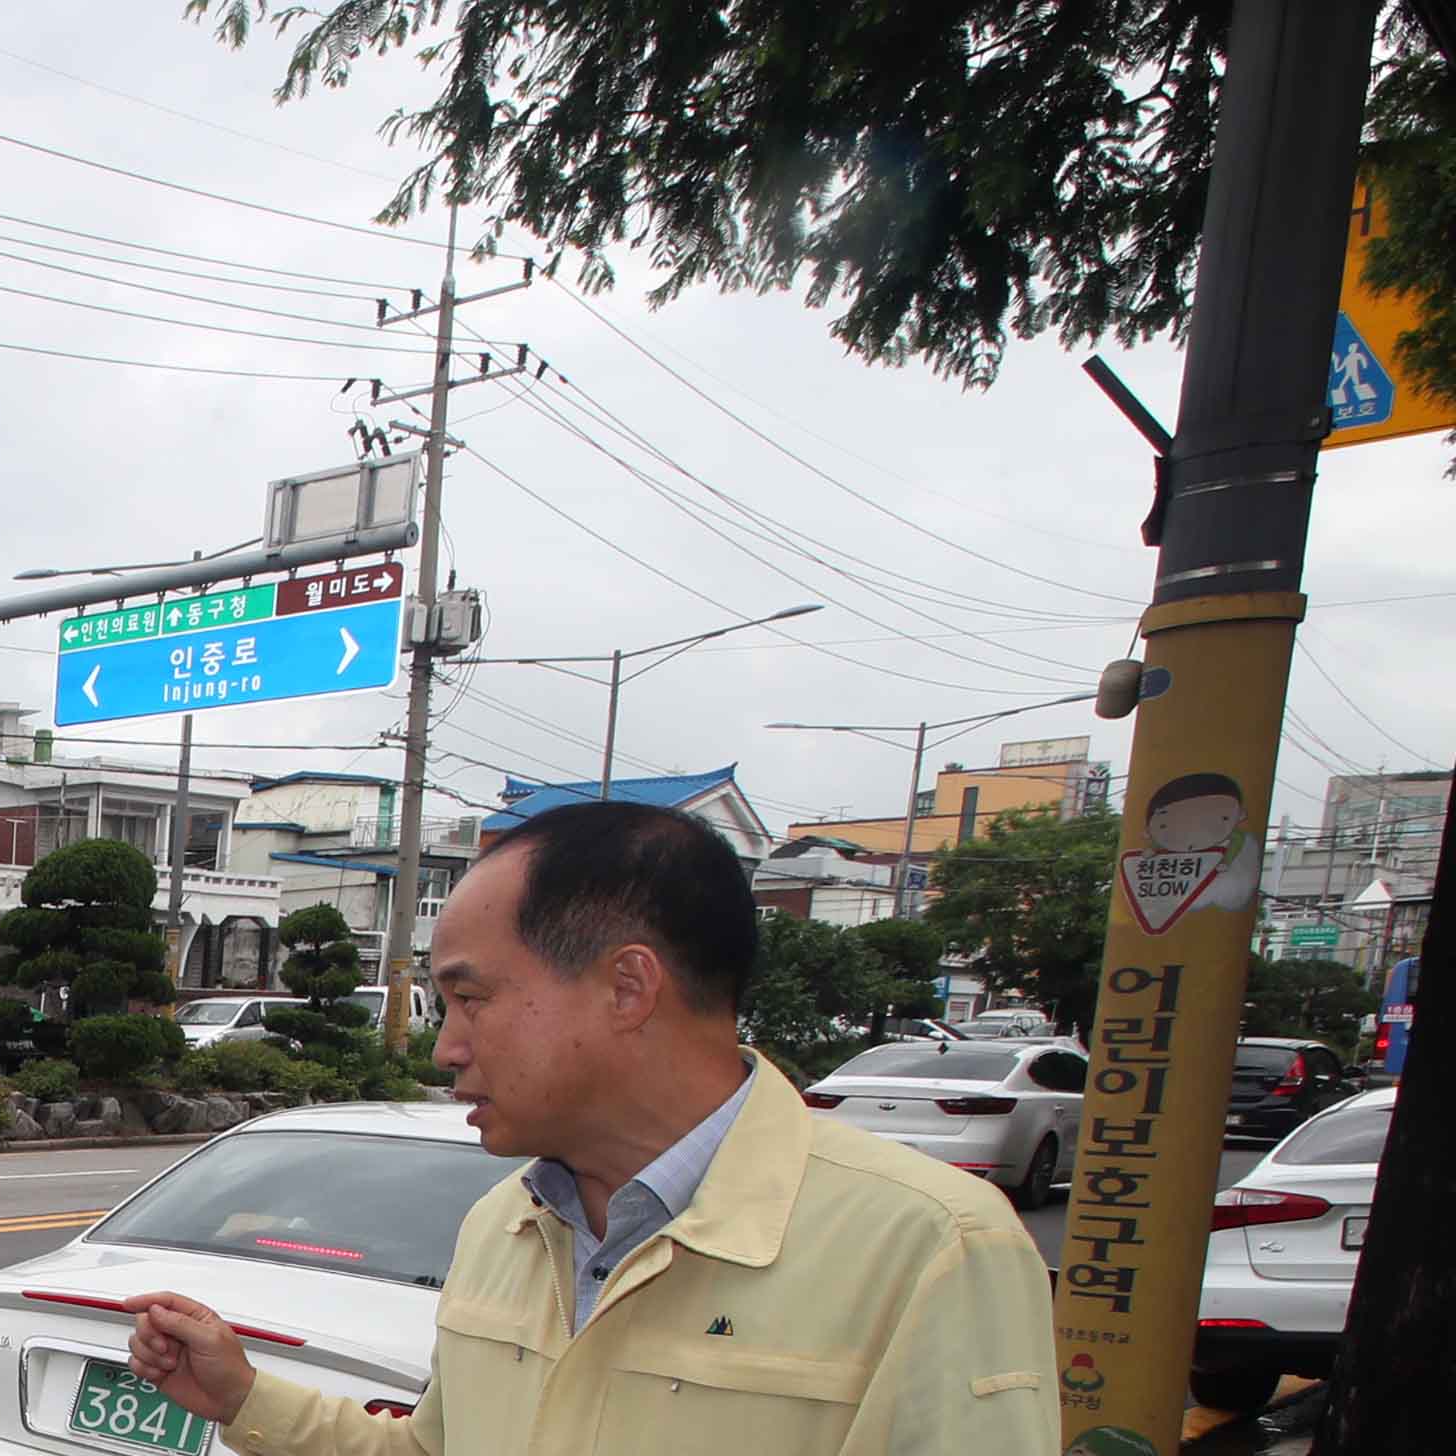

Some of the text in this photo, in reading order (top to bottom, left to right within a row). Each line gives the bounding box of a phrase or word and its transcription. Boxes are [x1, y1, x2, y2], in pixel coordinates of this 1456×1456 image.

[304, 573, 371, 607] 월미도
[80, 610, 158, 643] 인천의료원
[185, 594, 248, 626] 동구청
[169, 636, 258, 680] 인중로
[162, 674, 262, 705] Injung-ro
[1136, 856, 1202, 881] 천천히
[1137, 880, 1190, 898] SLOW
[1066, 964, 1186, 1314] 어린이보호구역
[79, 1386, 193, 1449] 3841
